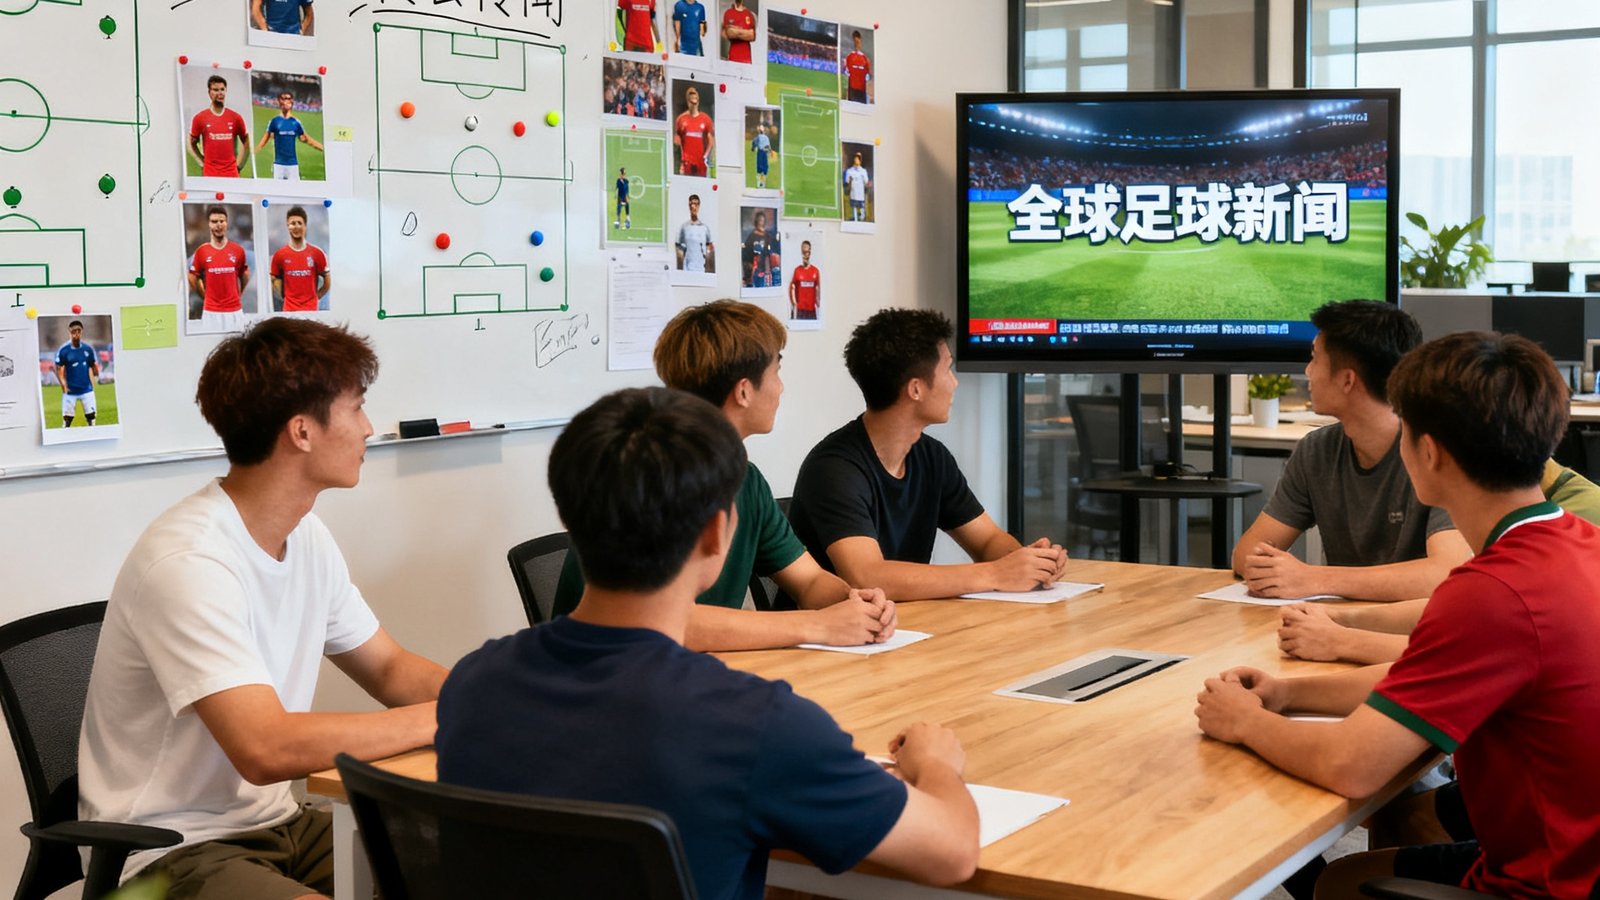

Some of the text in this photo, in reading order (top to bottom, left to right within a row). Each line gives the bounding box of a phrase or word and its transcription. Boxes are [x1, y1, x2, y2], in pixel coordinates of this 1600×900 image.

[1007, 181, 1348, 244] 全球足球新闻
